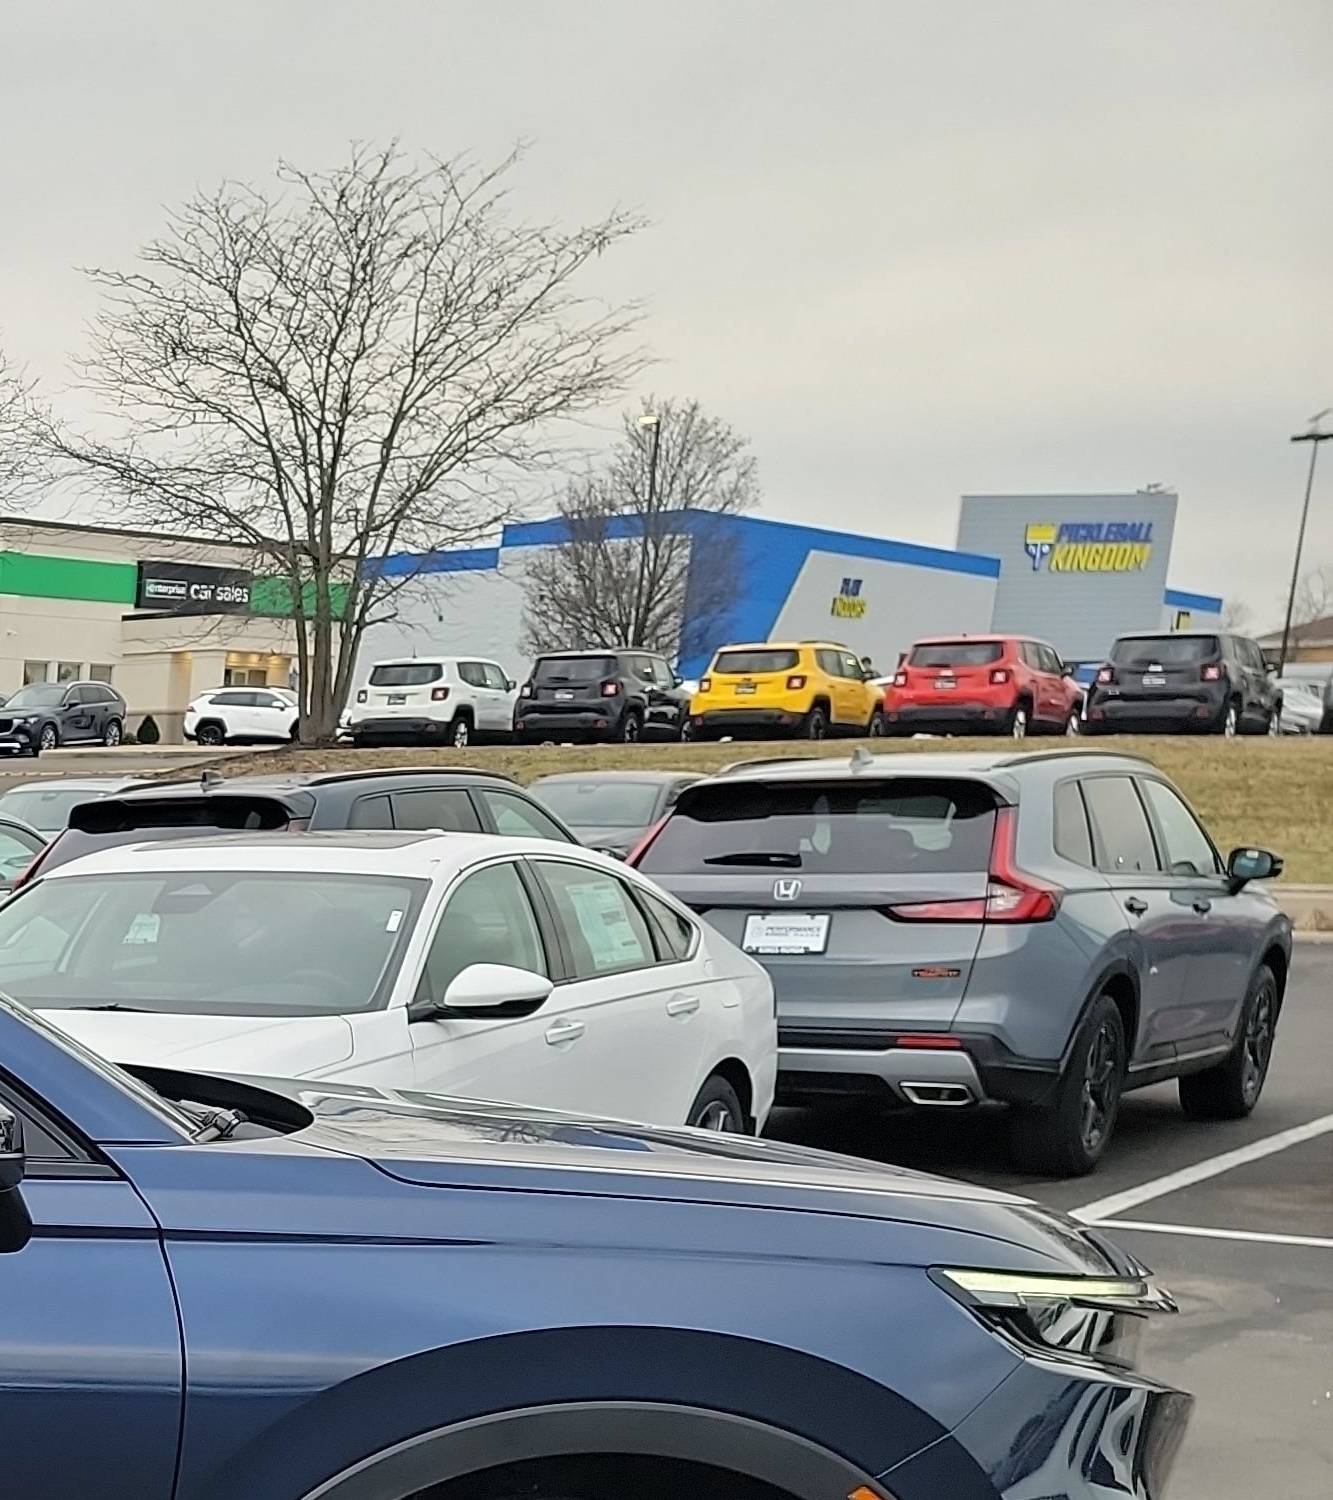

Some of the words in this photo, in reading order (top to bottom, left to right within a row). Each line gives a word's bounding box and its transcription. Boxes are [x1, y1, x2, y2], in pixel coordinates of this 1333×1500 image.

[1057, 522, 1153, 543] PICKLEBALL
[1049, 543, 1153, 573] KINGDOM
[190, 584, 215, 600] car
[216, 585, 249, 603] sales
